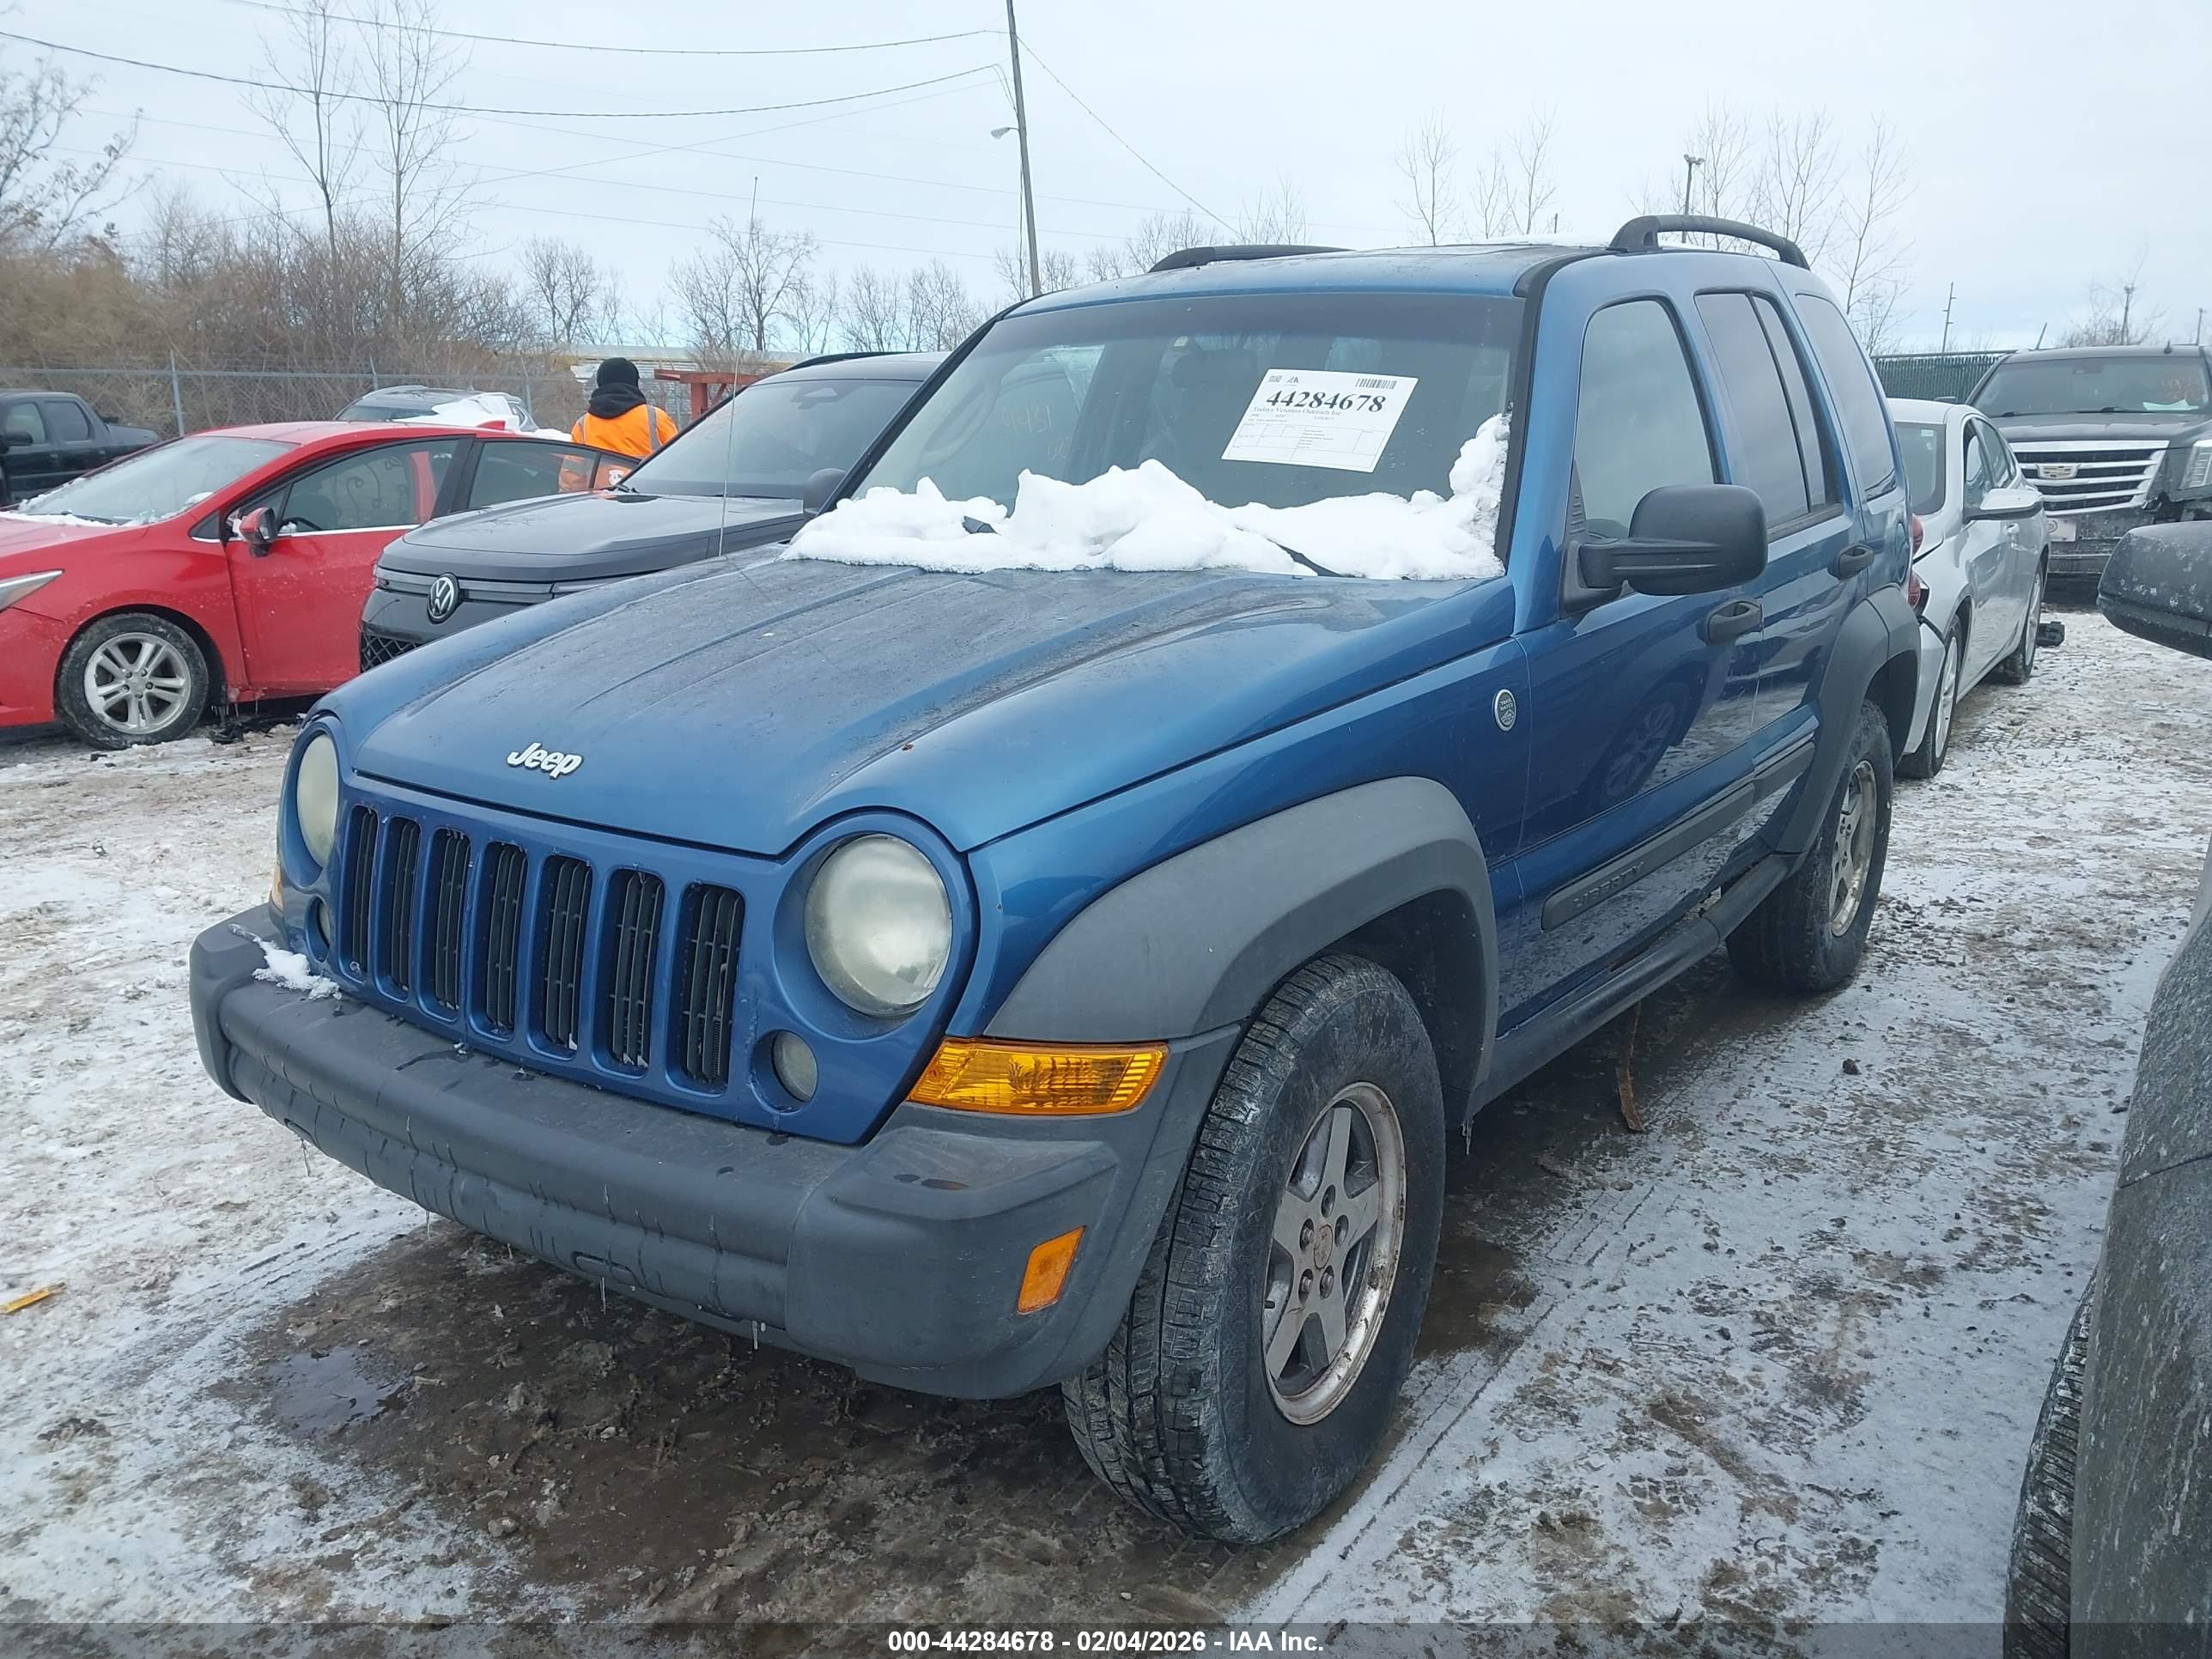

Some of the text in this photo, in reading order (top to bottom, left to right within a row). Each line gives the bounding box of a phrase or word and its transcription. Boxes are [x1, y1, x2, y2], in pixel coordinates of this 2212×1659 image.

[1266, 390, 1386, 412] 44284678
[507, 742, 584, 779] Jeep
[1572, 860, 1645, 908] LIBERTY
